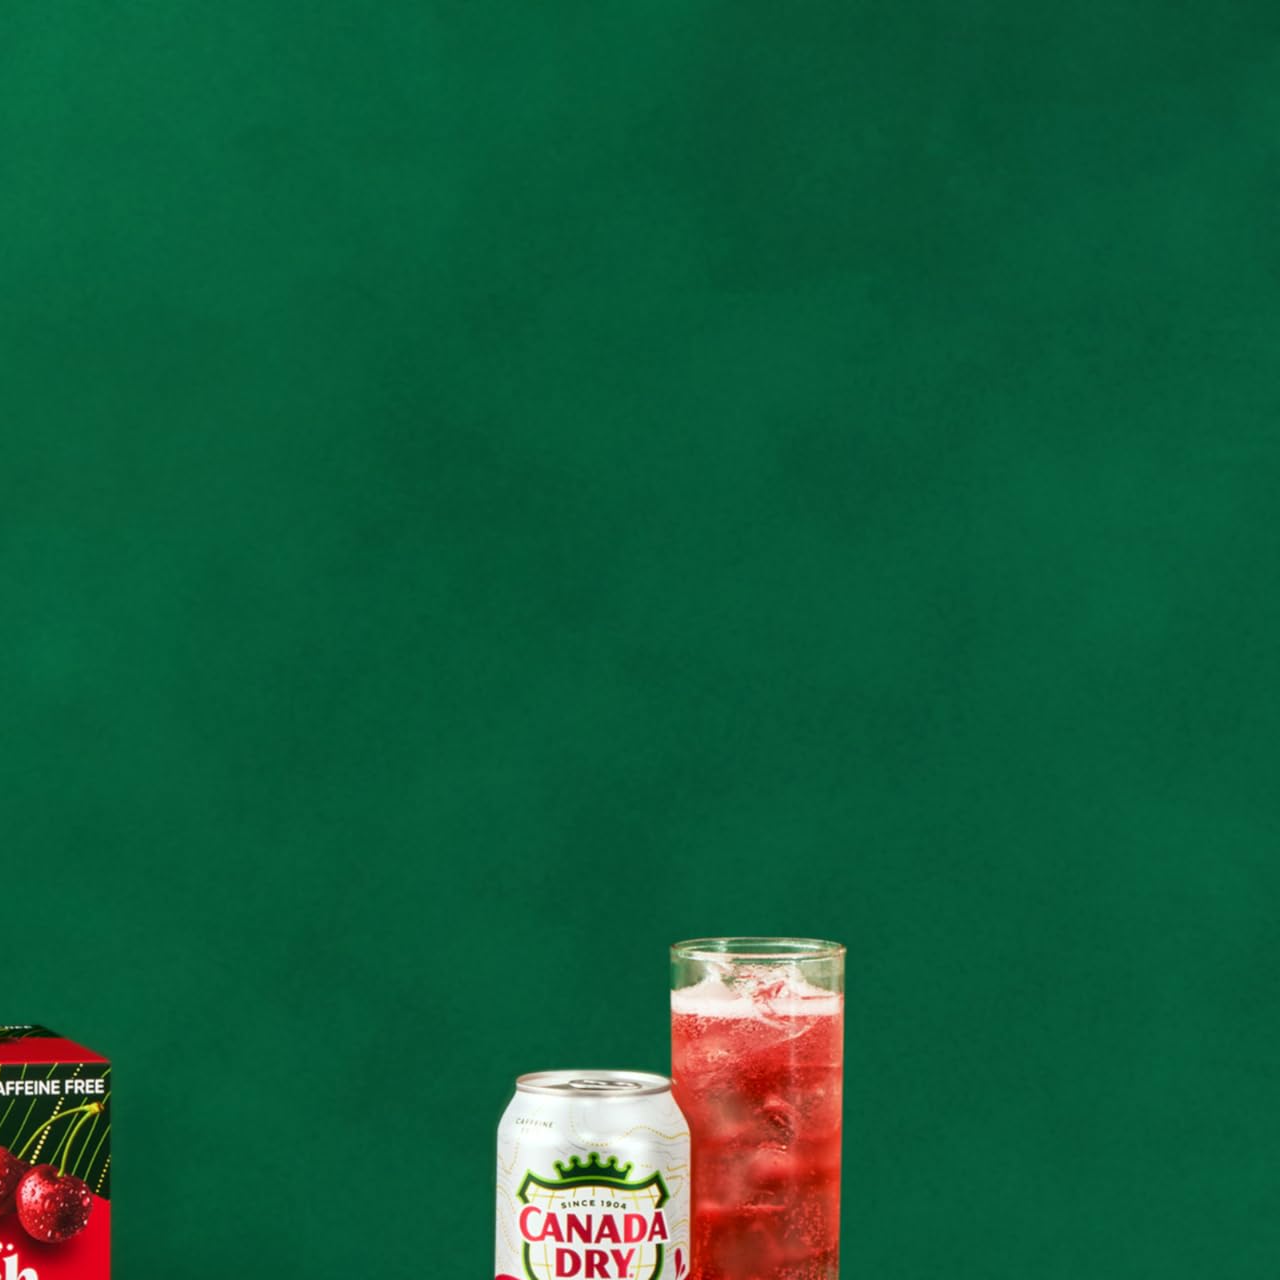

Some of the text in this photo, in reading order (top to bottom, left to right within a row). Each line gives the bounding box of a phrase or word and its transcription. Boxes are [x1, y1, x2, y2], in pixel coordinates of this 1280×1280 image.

[64, 1079, 105, 1095] FREE
[561, 1199, 627, 1210] SINCE 1904
[519, 1206, 668, 1244] CANADA
